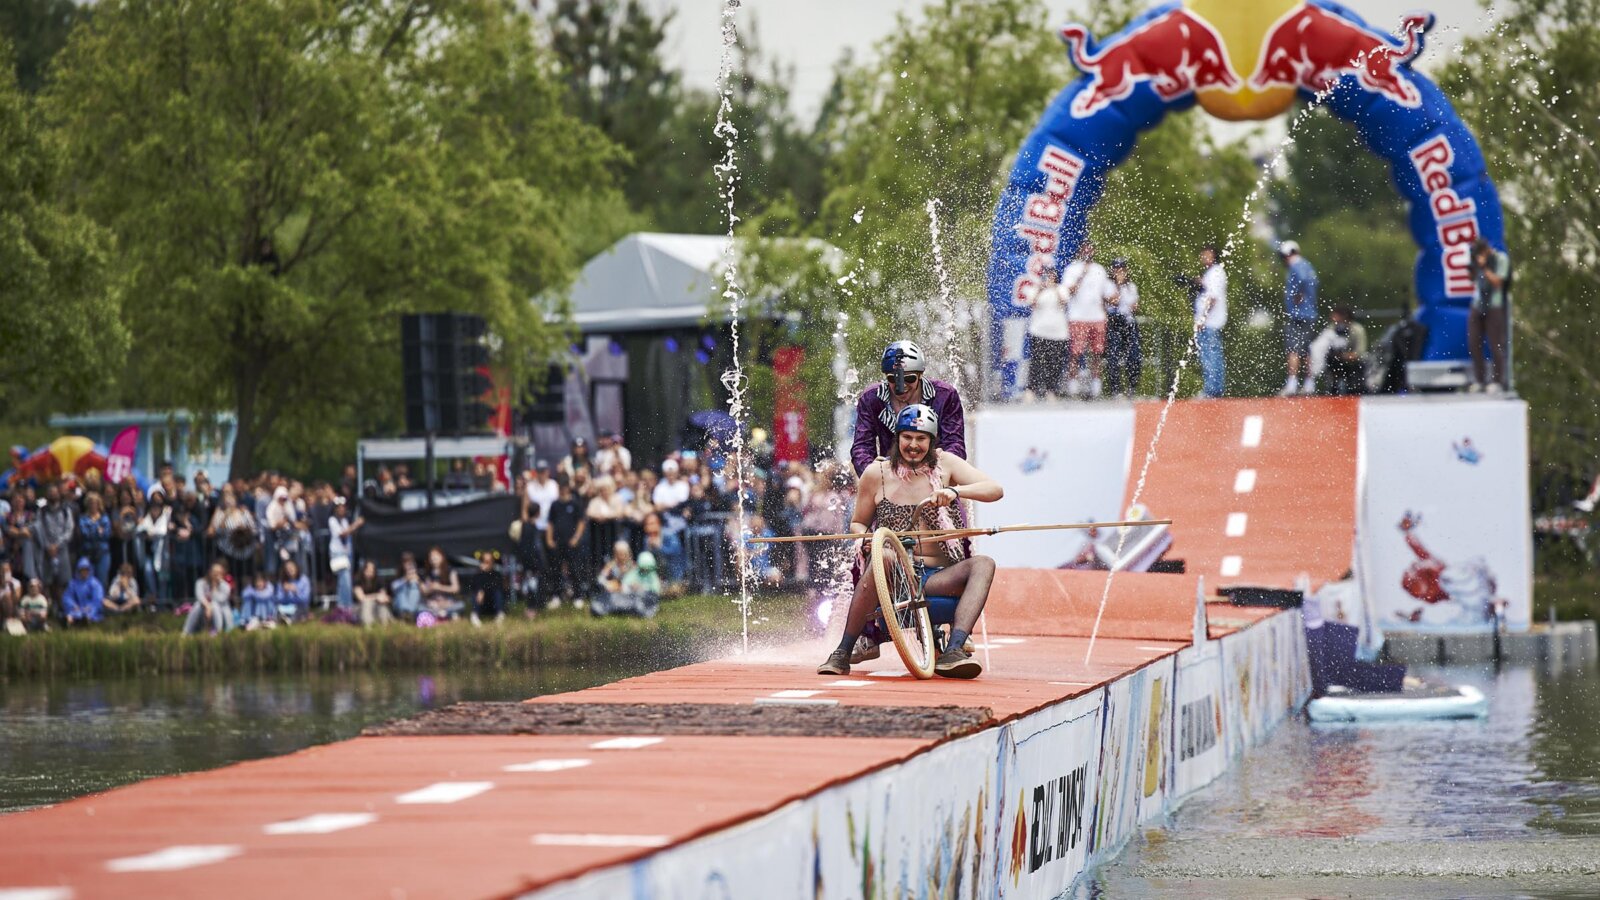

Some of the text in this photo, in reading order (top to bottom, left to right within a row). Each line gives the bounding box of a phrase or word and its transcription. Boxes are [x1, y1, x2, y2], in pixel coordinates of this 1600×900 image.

[1025, 147, 1083, 225] Bull
[1412, 137, 1476, 294] Red Bull
